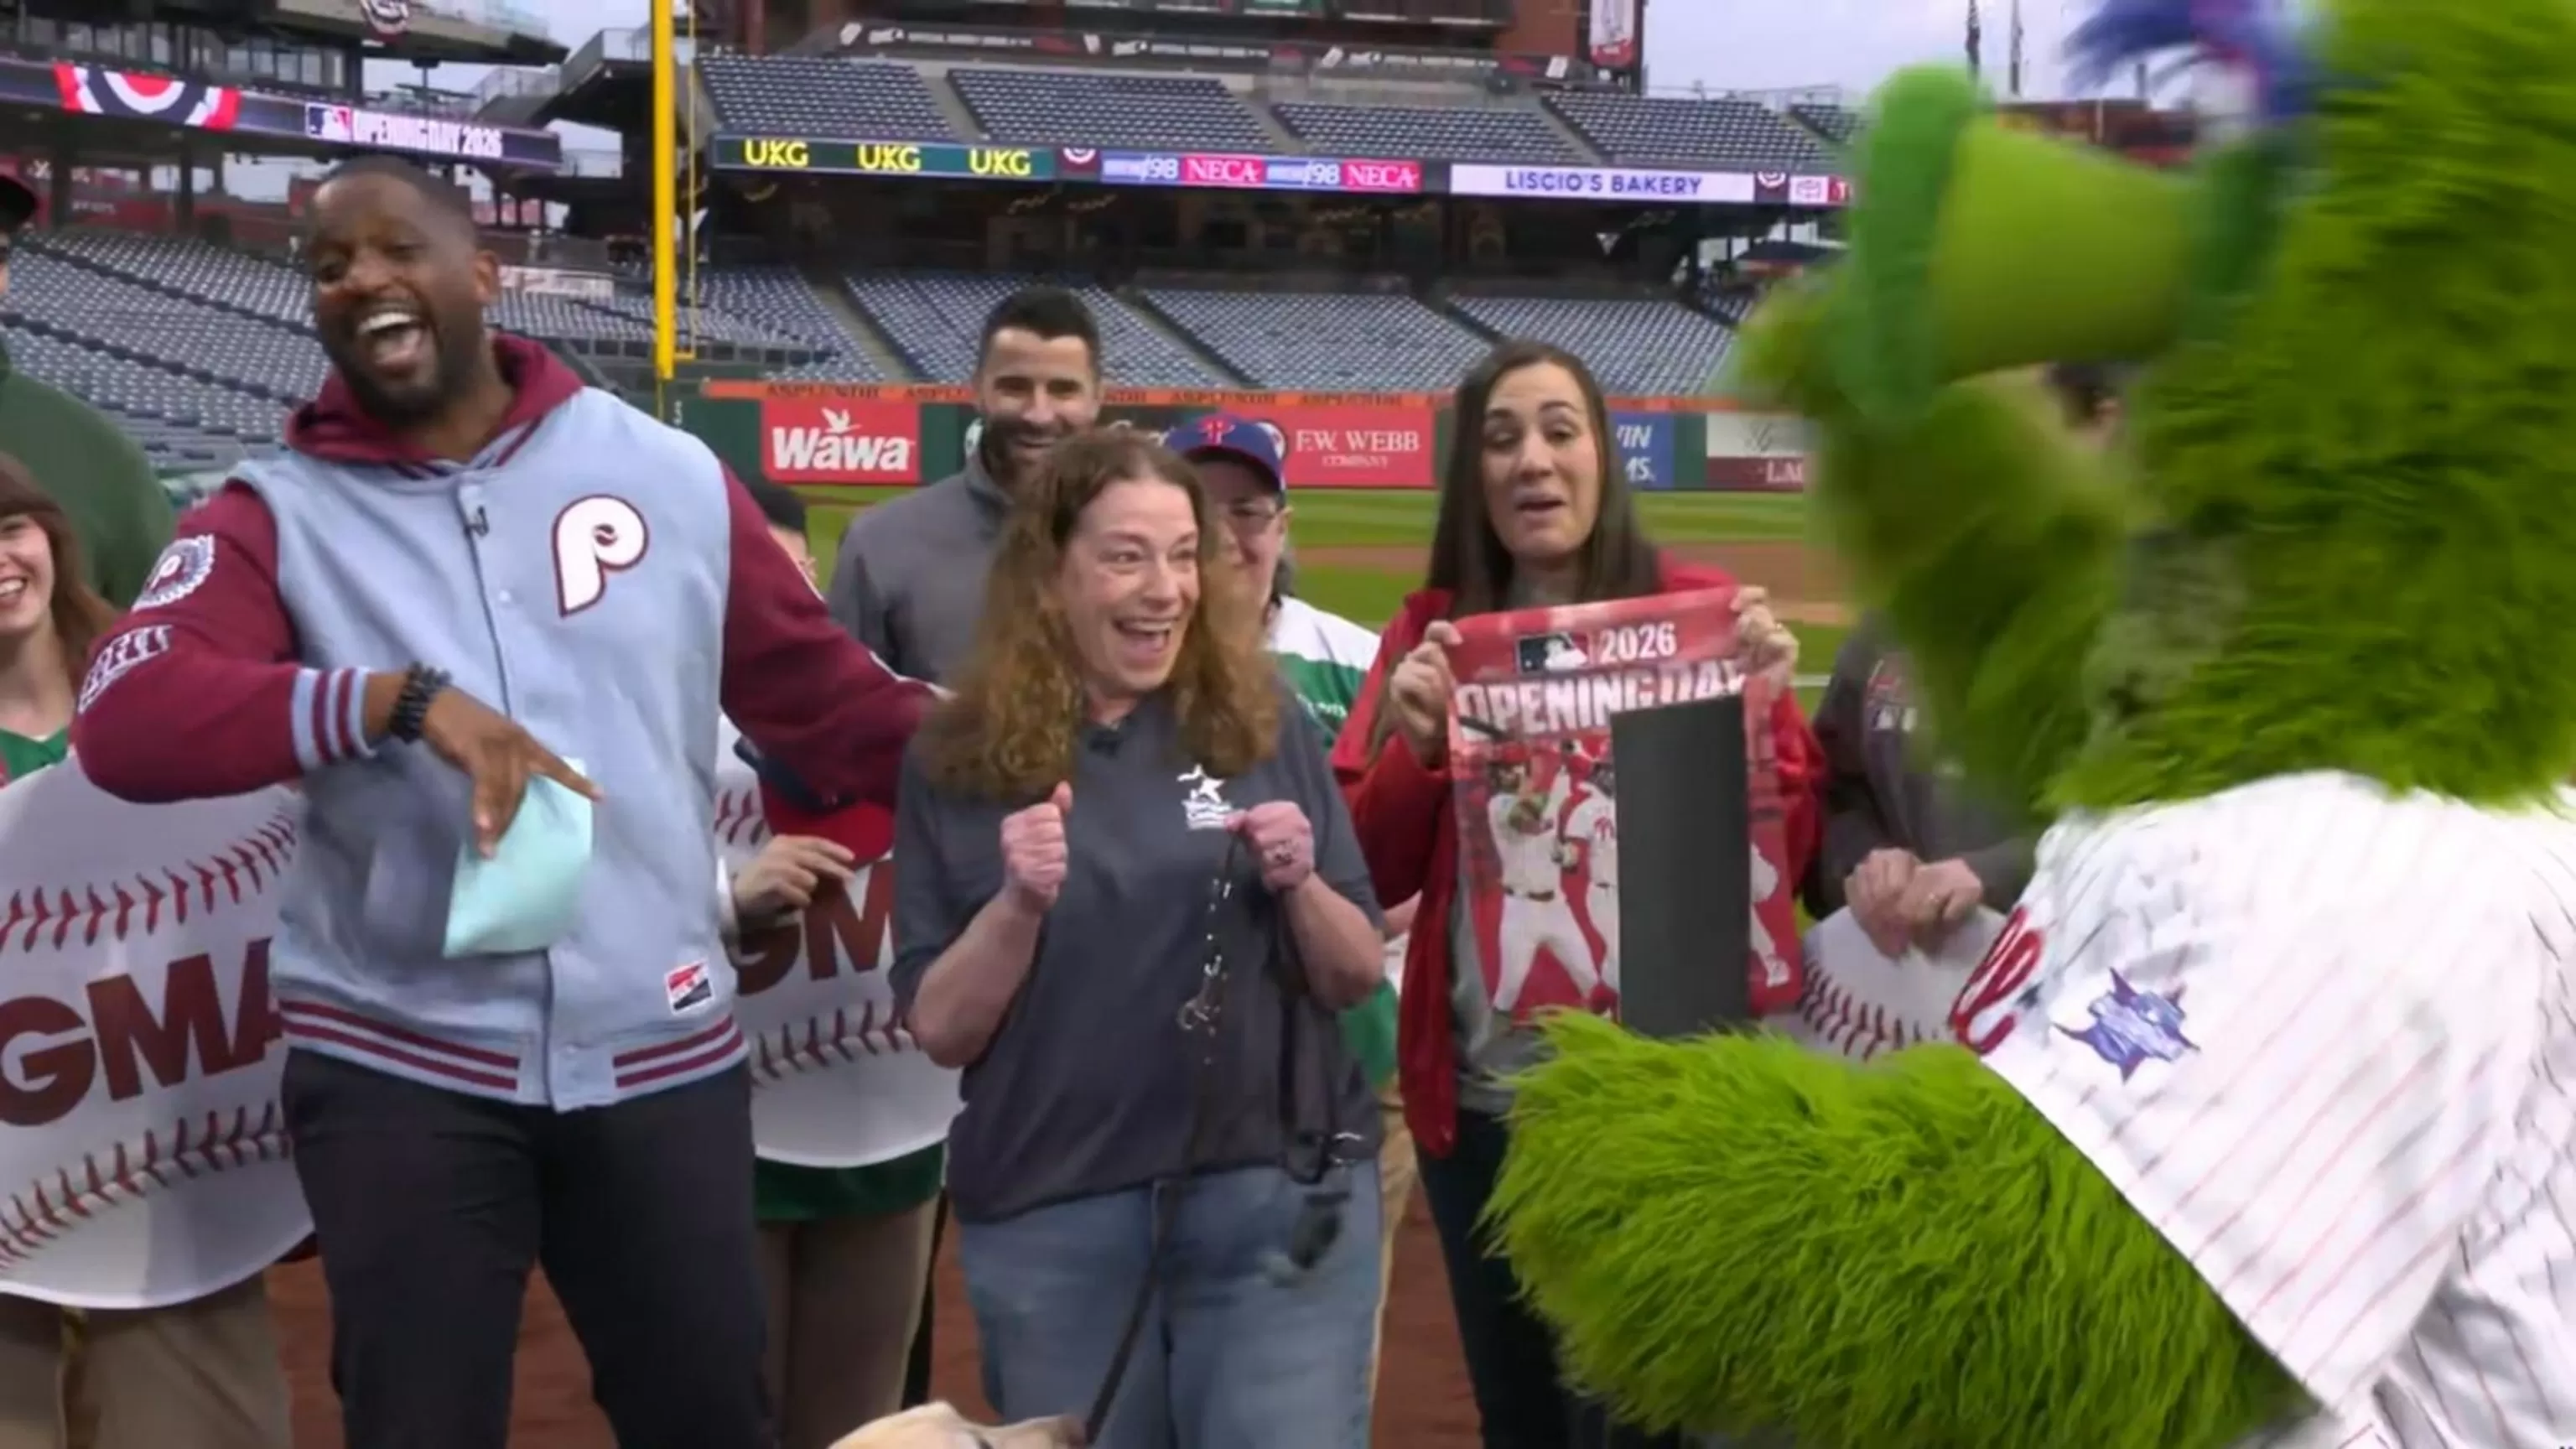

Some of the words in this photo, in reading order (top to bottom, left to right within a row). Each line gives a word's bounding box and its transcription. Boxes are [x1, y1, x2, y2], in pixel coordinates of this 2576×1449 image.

[744, 139, 809, 167] UKG
[857, 143, 921, 171] UKG
[969, 148, 1031, 176] UKG
[1187, 157, 1259, 184] NECA
[1347, 164, 1419, 189] NECA
[1505, 170, 1603, 193] LISCIO'S
[1611, 174, 1703, 195] BAKERY
[771, 427, 909, 471] Wawa
[1345, 430, 1420, 452] WEBB
[550, 493, 650, 619] P
[1599, 621, 1677, 664] 2026
[1454, 669, 1654, 743] OPENING
